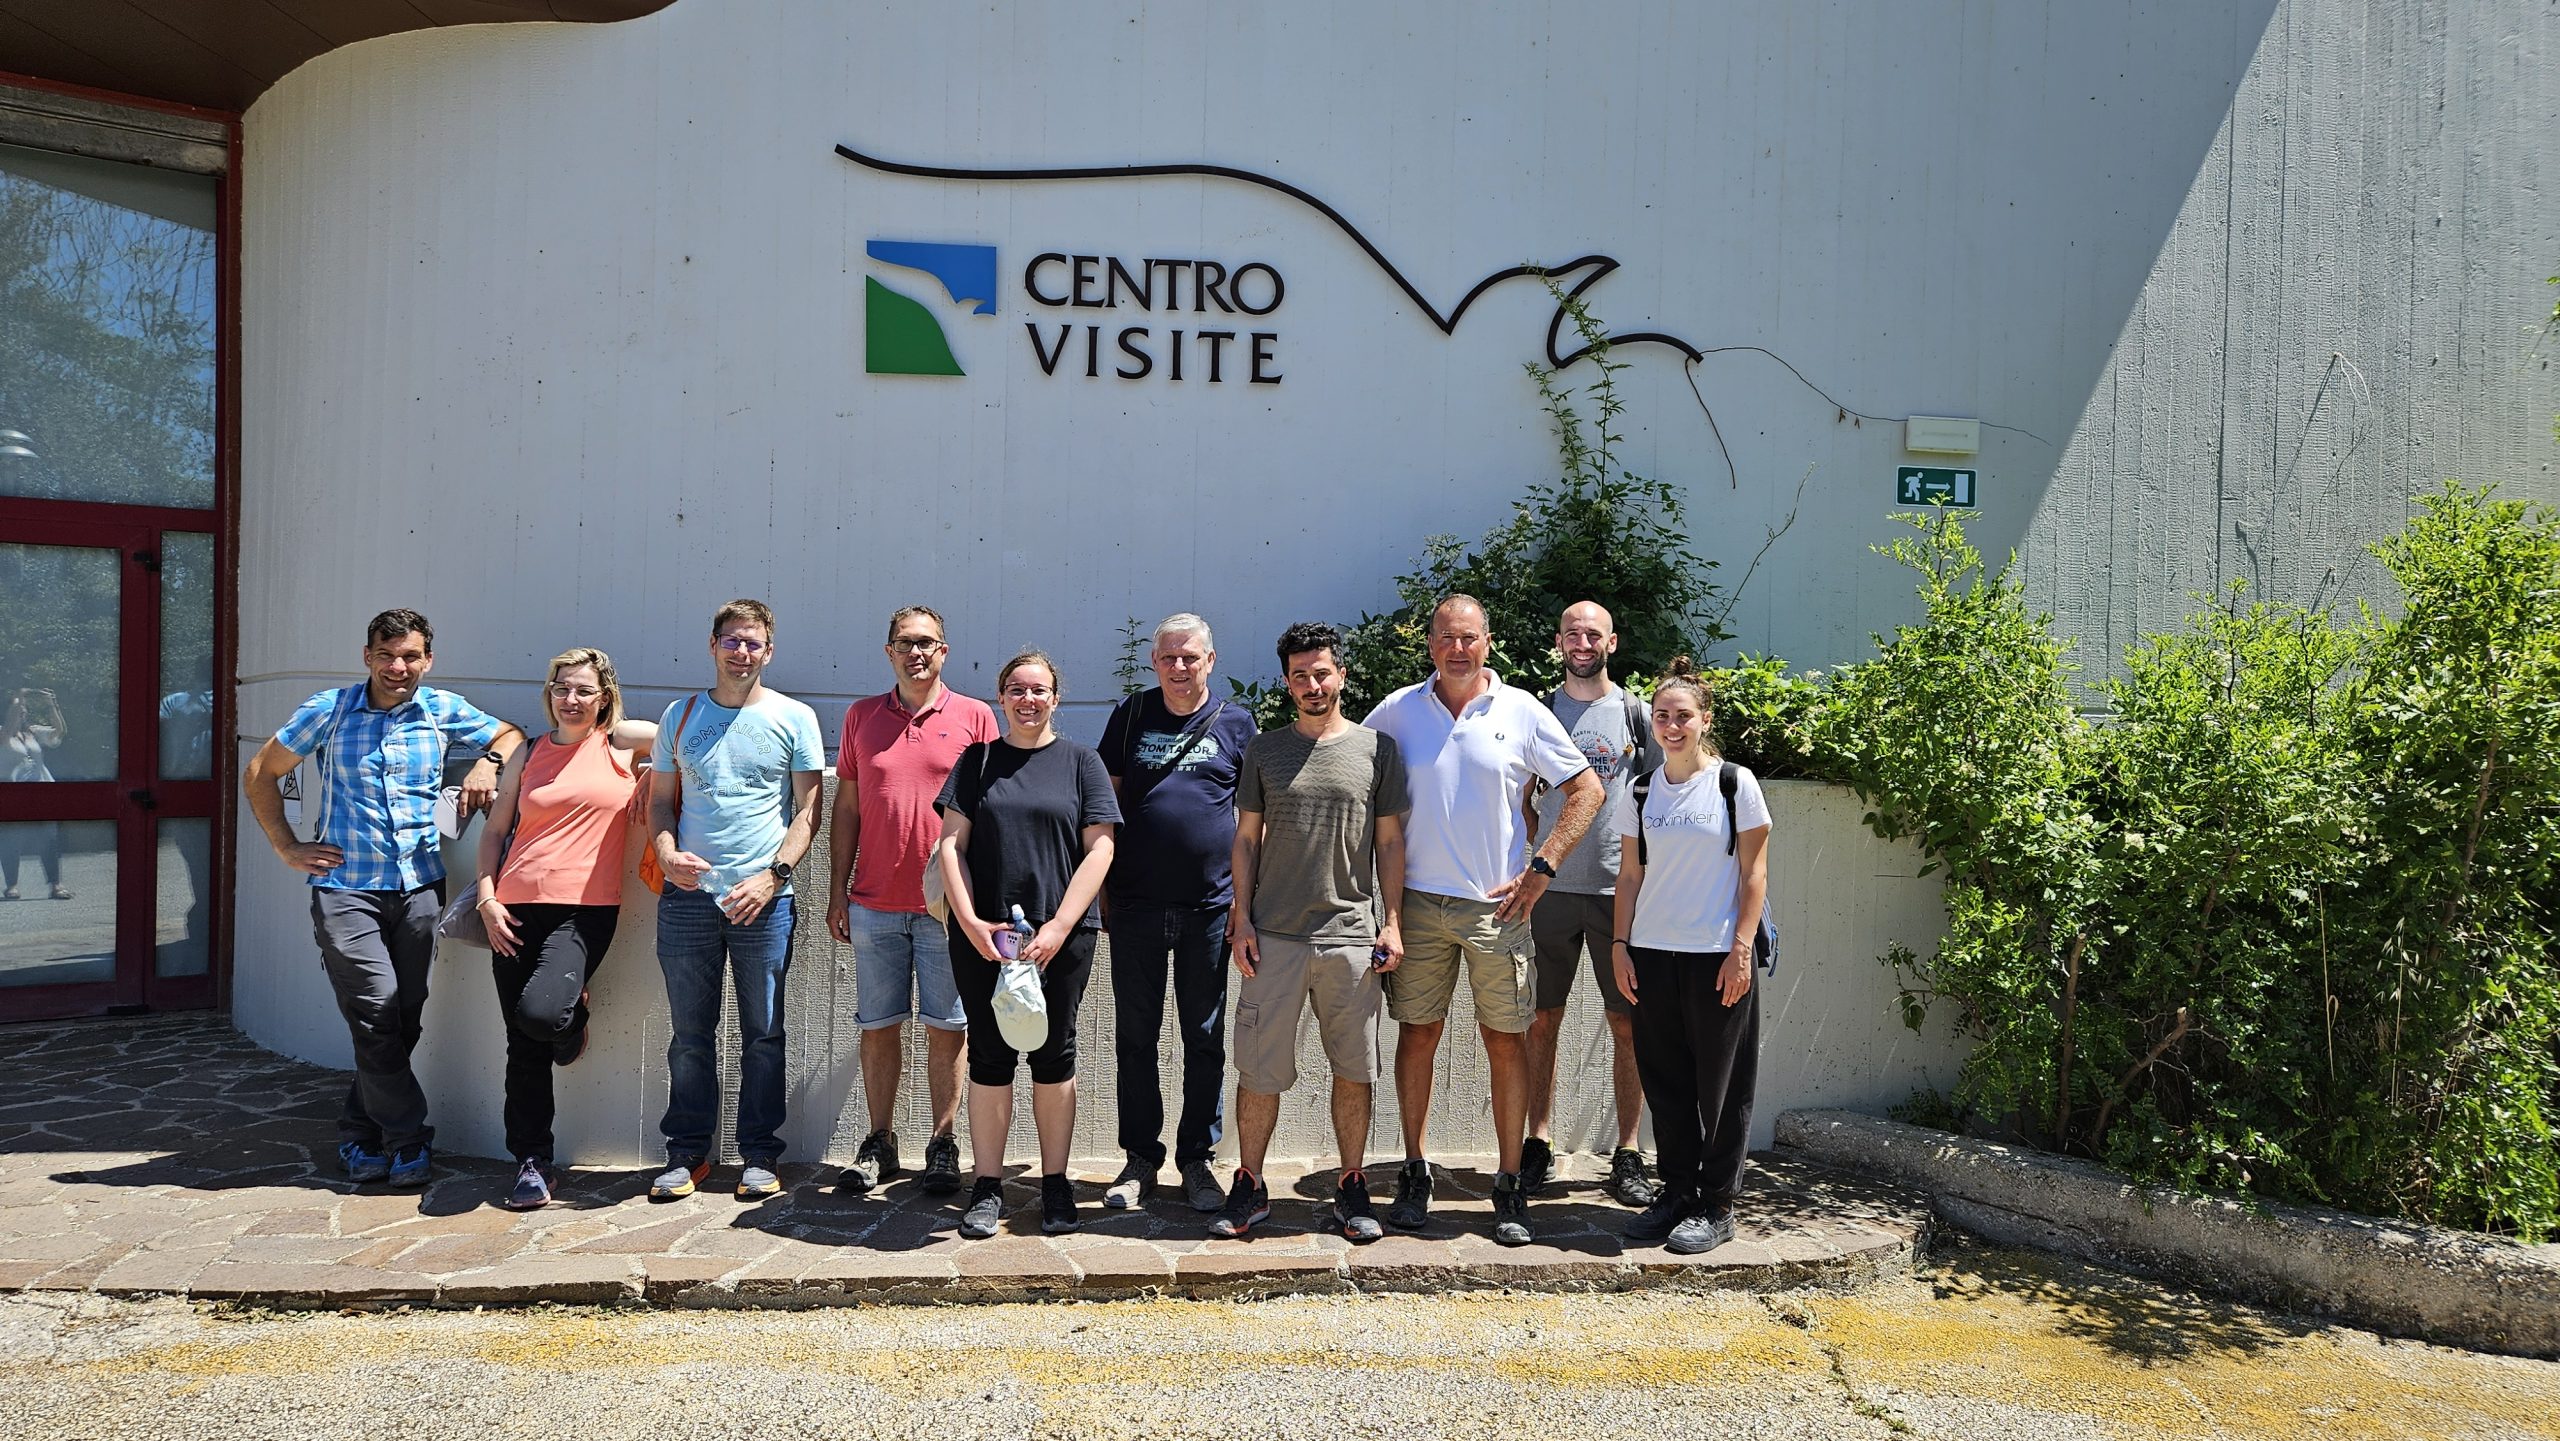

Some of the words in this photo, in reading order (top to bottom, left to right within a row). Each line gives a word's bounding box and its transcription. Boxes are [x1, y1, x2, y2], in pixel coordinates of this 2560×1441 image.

[1024, 252, 1285, 316] CENTRO
[1025, 323, 1283, 384] VISITE
[683, 725, 717, 756] TOM
[719, 721, 772, 755] TAILOR
[1142, 744, 1167, 753] TOM
[1168, 744, 1210, 755] TAOR
[1643, 812, 1682, 829] Calvin
[1684, 810, 1719, 825] Klein
